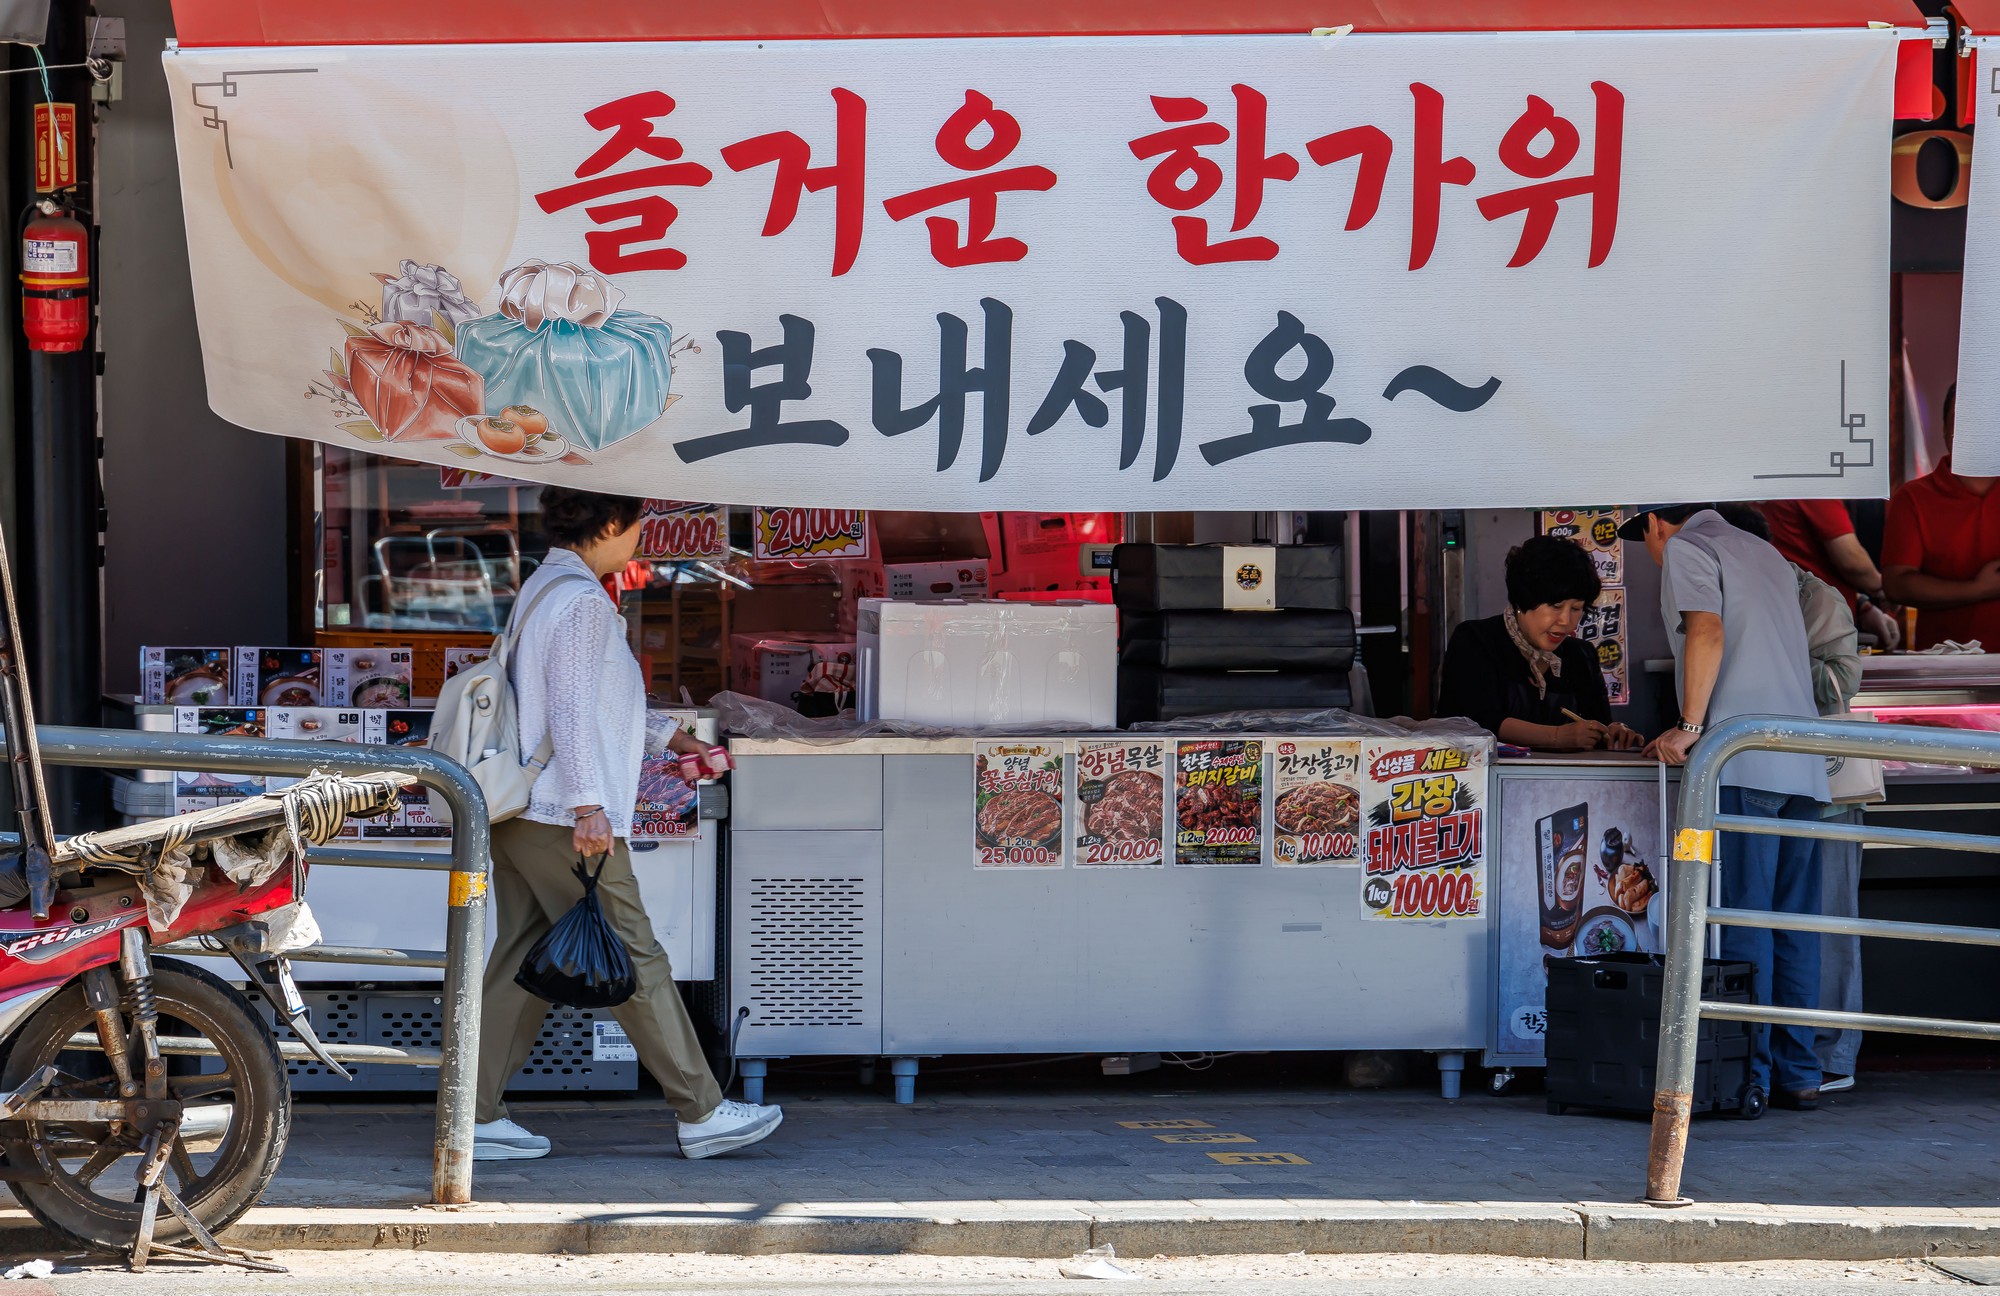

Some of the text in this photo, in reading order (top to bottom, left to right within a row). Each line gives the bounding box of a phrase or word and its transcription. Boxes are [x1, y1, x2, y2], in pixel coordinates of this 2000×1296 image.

[56, 113, 72, 121] 소화기
[534, 80, 1625, 277] 즐거운 한가위
[673, 296, 1502, 483] 보내세요~
[641, 517, 723, 557] 10000원
[768, 507, 862, 553] 20,000원
[1552, 527, 1572, 536] 600g
[1594, 523, 1615, 541] 한근
[153, 670, 162, 704] 한지곰
[246, 672, 255, 705] 한마리곰
[1280, 744, 1294, 754] 한돈
[1004, 756, 1030, 771] 양념
[1181, 751, 1212, 771] 한돈
[1278, 746, 1359, 780] 간장불고기
[1376, 748, 1469, 777] 신상품 세일!
[980, 769, 1060, 793] 꽃등심구이
[1186, 764, 1258, 788] 돼지갈비
[642, 803, 664, 811] 1.2kg
[1391, 774, 1456, 822] 간장
[1006, 836, 1032, 847] 1.2kg
[1082, 836, 1101, 845] 1.2kg
[1180, 832, 1203, 844] 1.2kg
[1205, 827, 1260, 846] 20,000원
[1366, 809, 1482, 874] 돼지불고기
[981, 847, 1057, 864] 25,000원
[1277, 840, 1296, 858] 1kg
[1367, 884, 1389, 903] 1kg
[1391, 873, 1480, 916] 10000원
